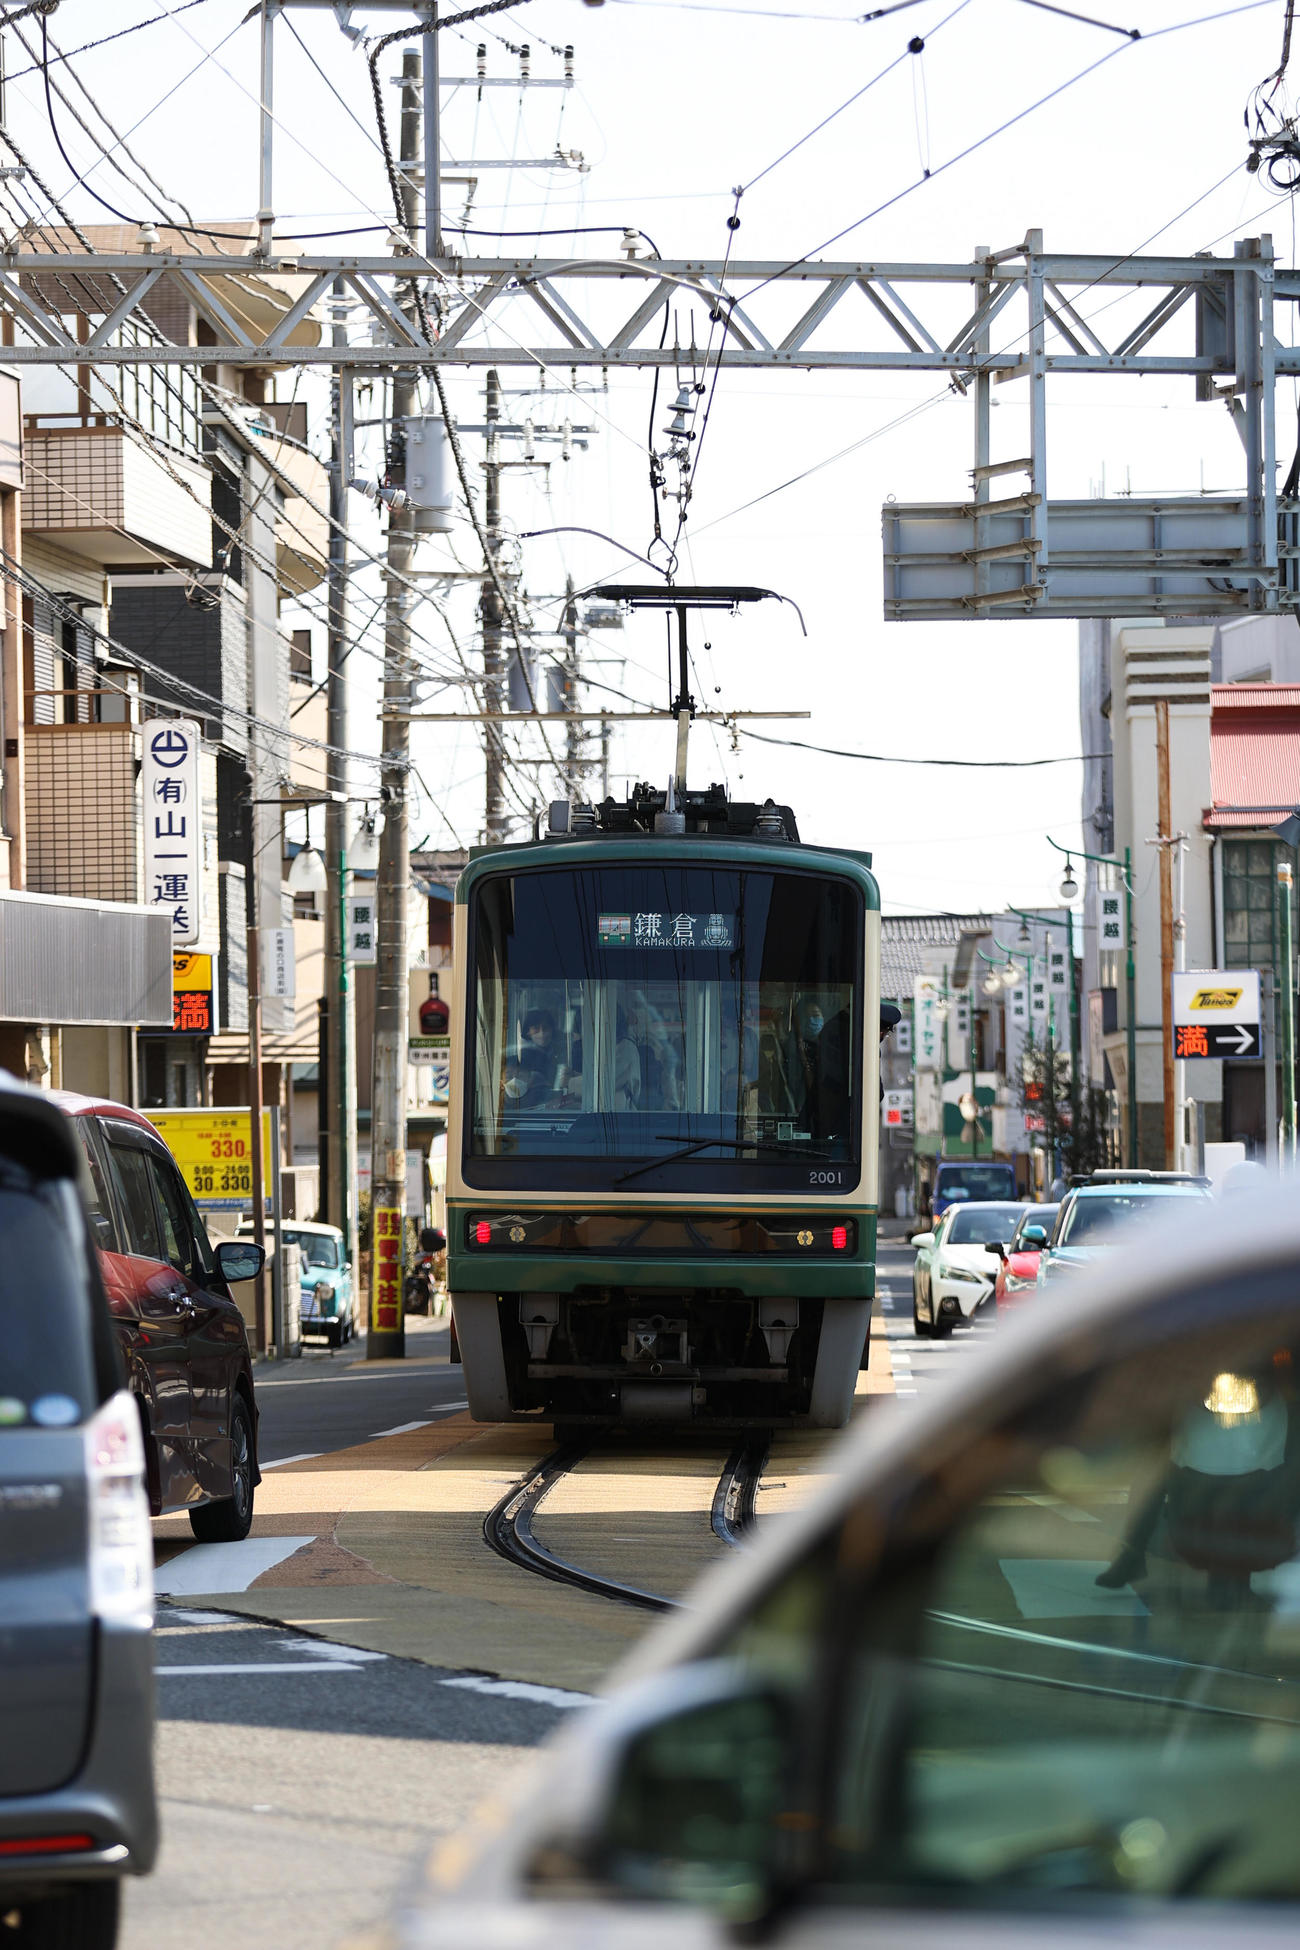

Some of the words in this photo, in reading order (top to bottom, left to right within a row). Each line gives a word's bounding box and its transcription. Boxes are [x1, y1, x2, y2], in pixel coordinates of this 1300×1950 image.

[354, 907, 371, 949] 腰越
[634, 912, 697, 938] 鎌倉
[1103, 899, 1119, 938] 腰越
[636, 938, 695, 947] KAMAKURA
[172, 993, 209, 1031] 満
[1198, 991, 1239, 1008] Times
[1176, 1025, 1208, 1057] 満
[809, 1171, 842, 1185] 2001
